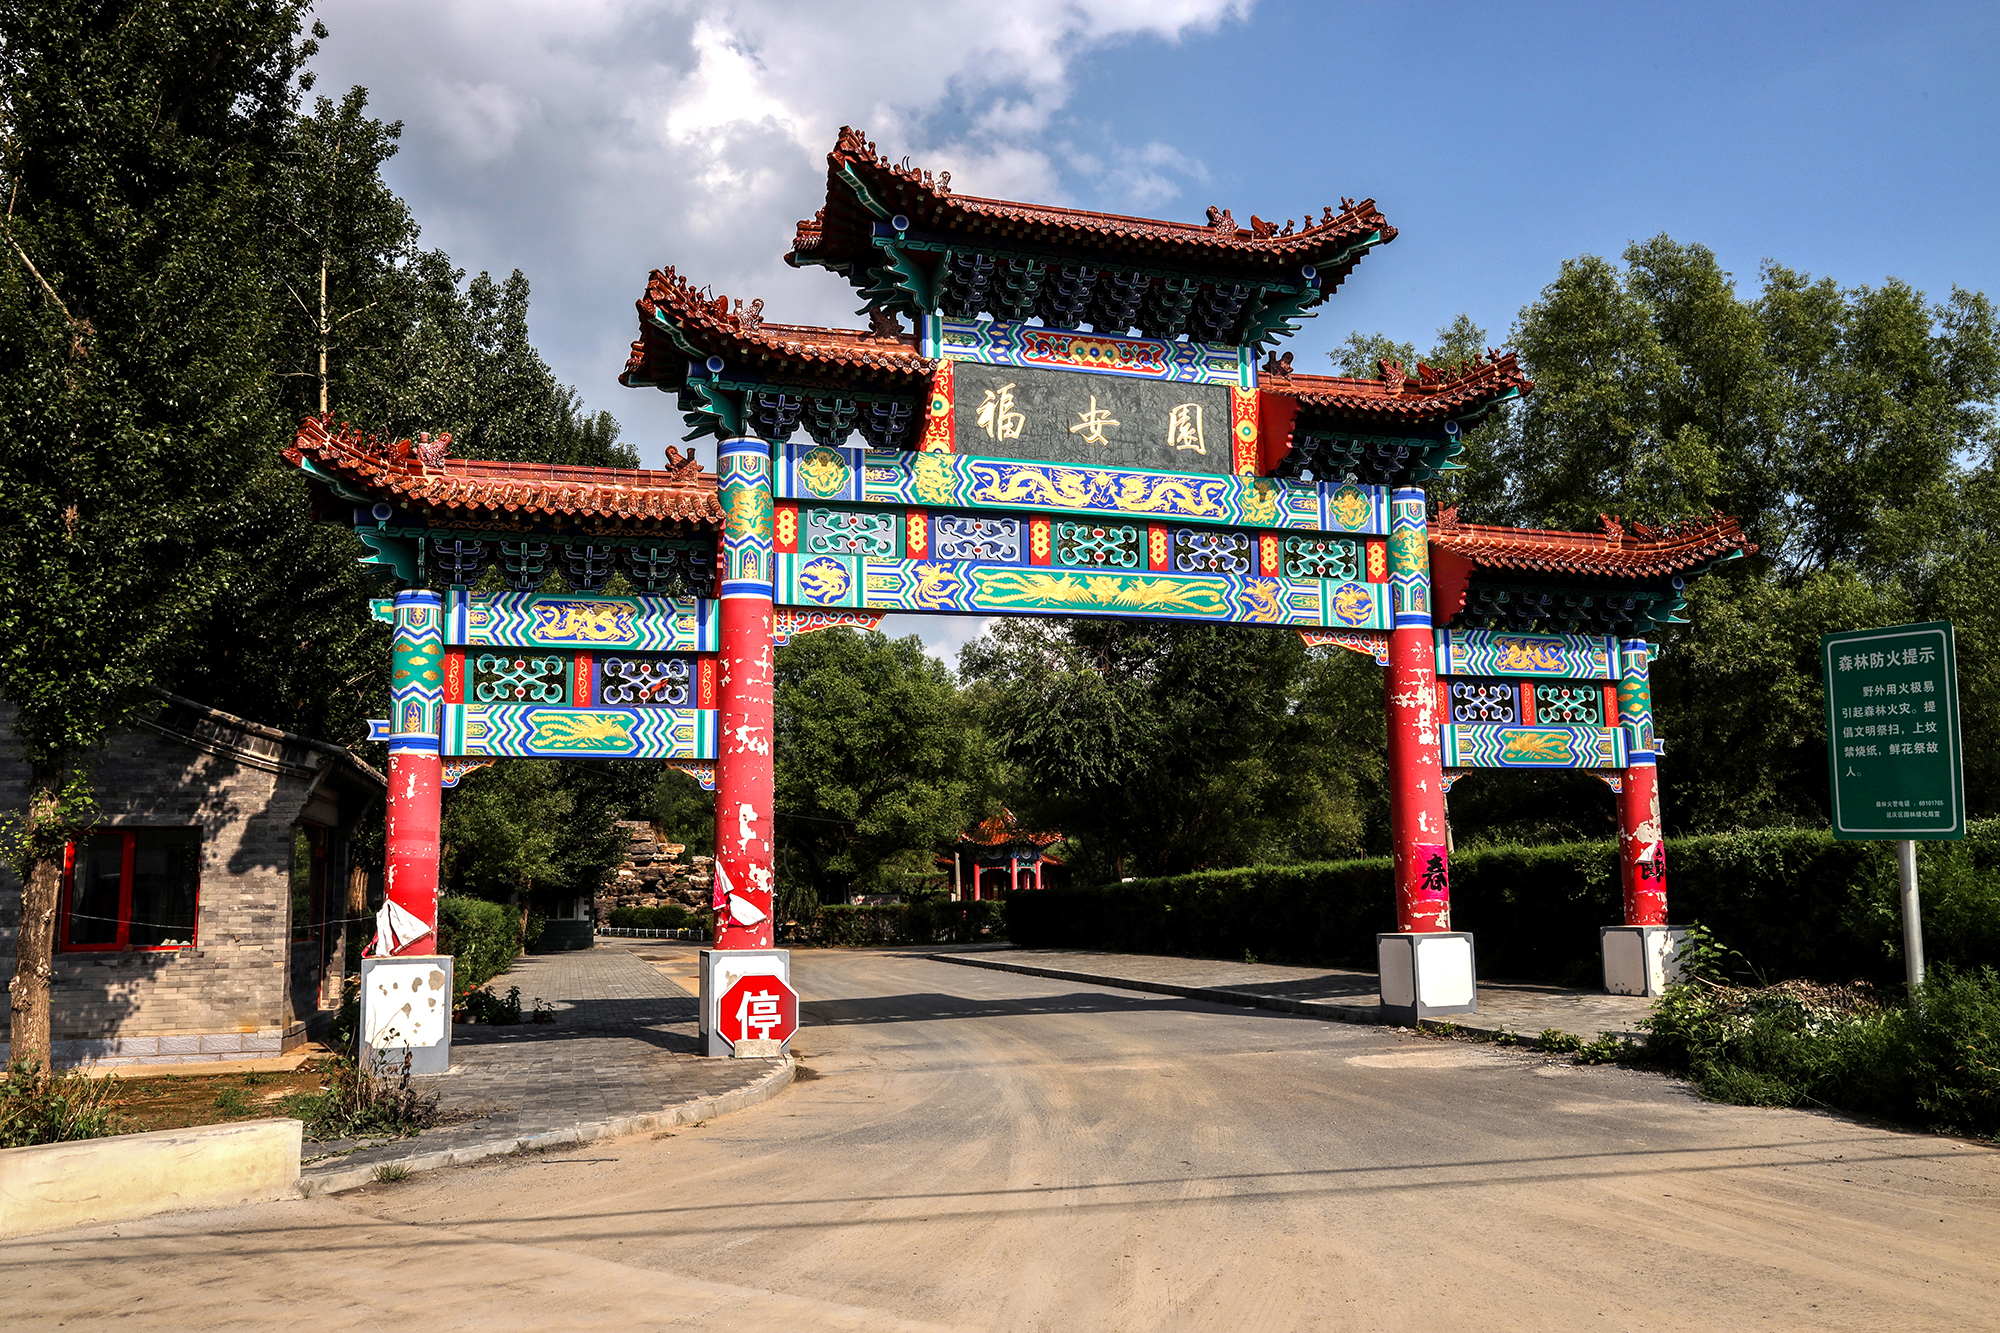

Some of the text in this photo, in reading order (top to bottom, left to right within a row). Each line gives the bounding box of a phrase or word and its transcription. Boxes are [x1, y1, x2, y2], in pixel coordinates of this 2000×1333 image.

[1838, 646, 1935, 672] 森林防火提示
[1862, 680, 1935, 698] 野外用火极易
[1845, 766, 1862, 777] 人。
[1421, 853, 1447, 891] 春
[735, 989, 782, 1040] 停
